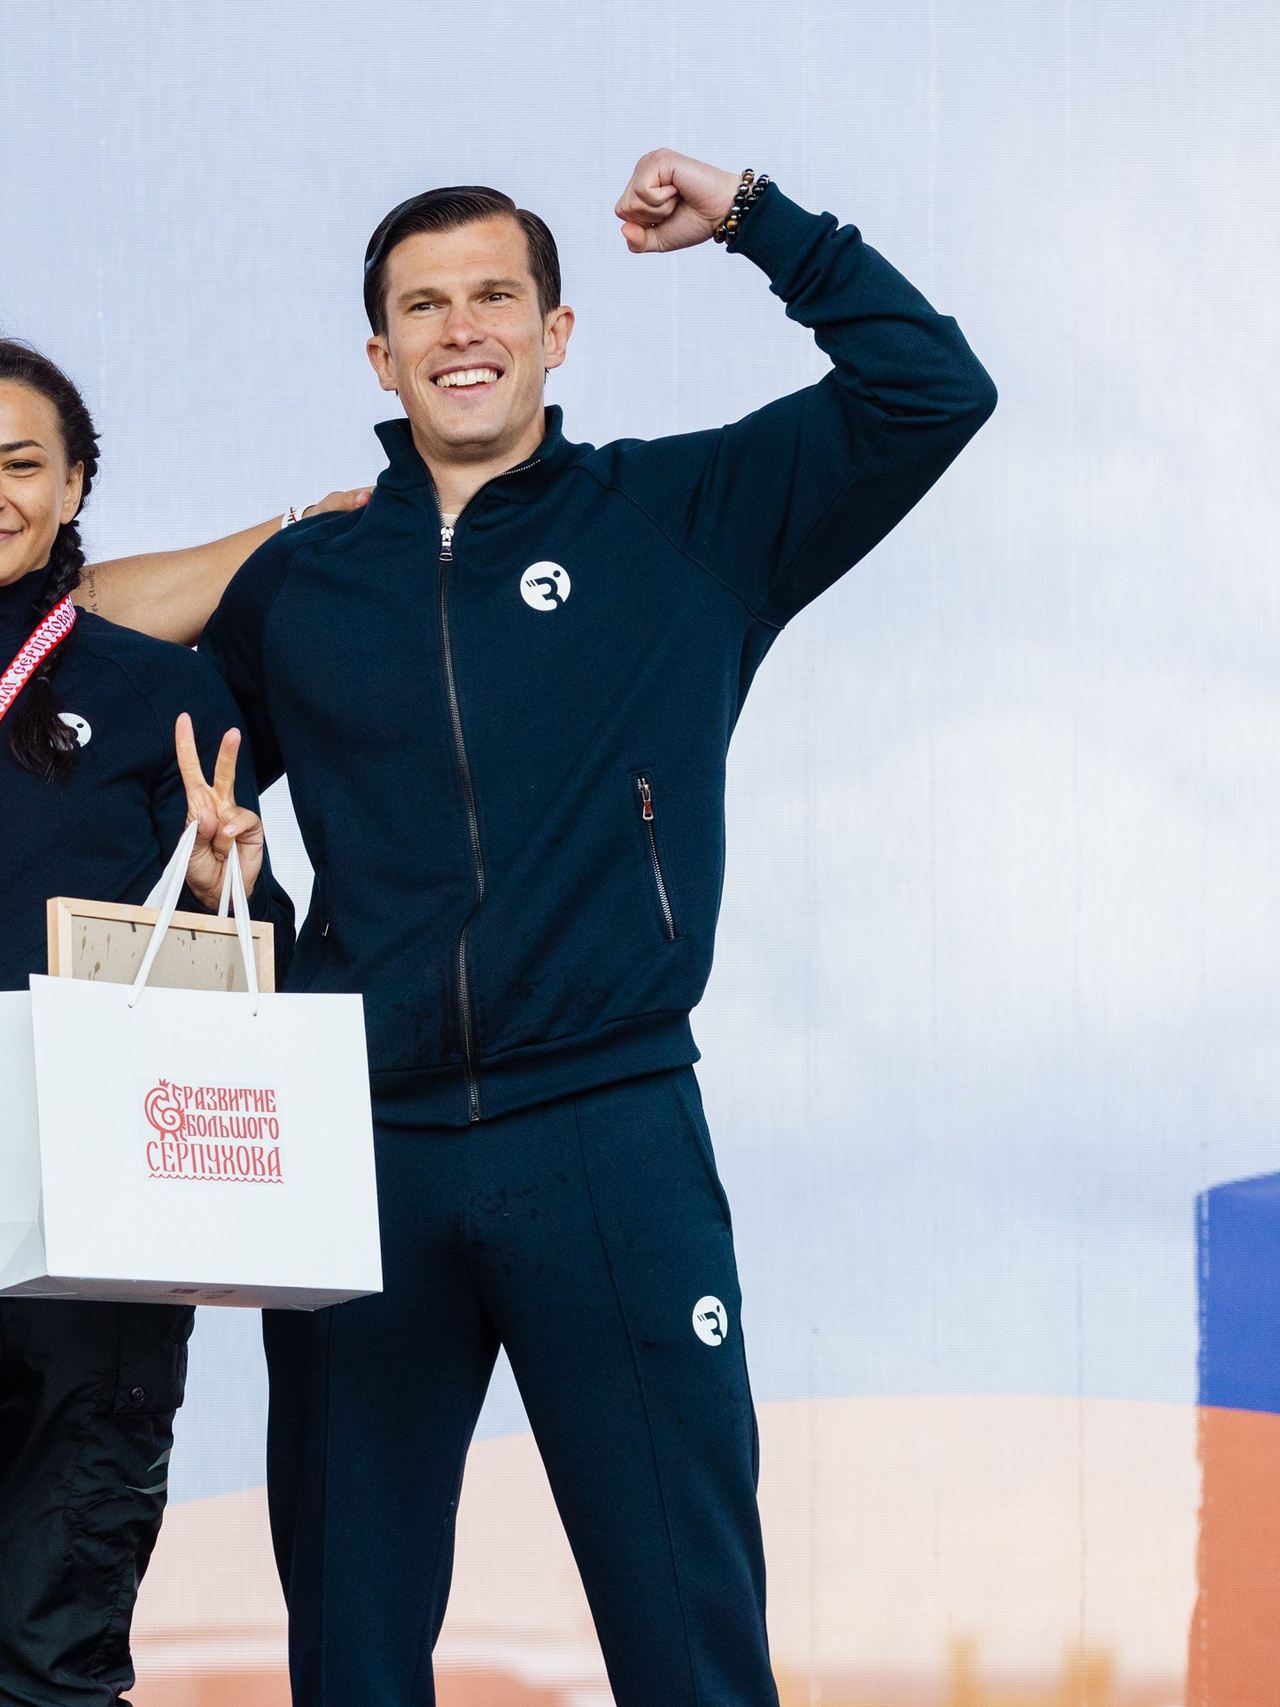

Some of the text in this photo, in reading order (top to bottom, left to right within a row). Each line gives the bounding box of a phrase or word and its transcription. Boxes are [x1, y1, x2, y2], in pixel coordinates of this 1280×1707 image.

[183, 1085, 277, 1113] РАЗВИТИЕ
[185, 1113, 280, 1141] БОЛЬШОГО
[146, 1140, 282, 1178] СЕРПУХОВА
